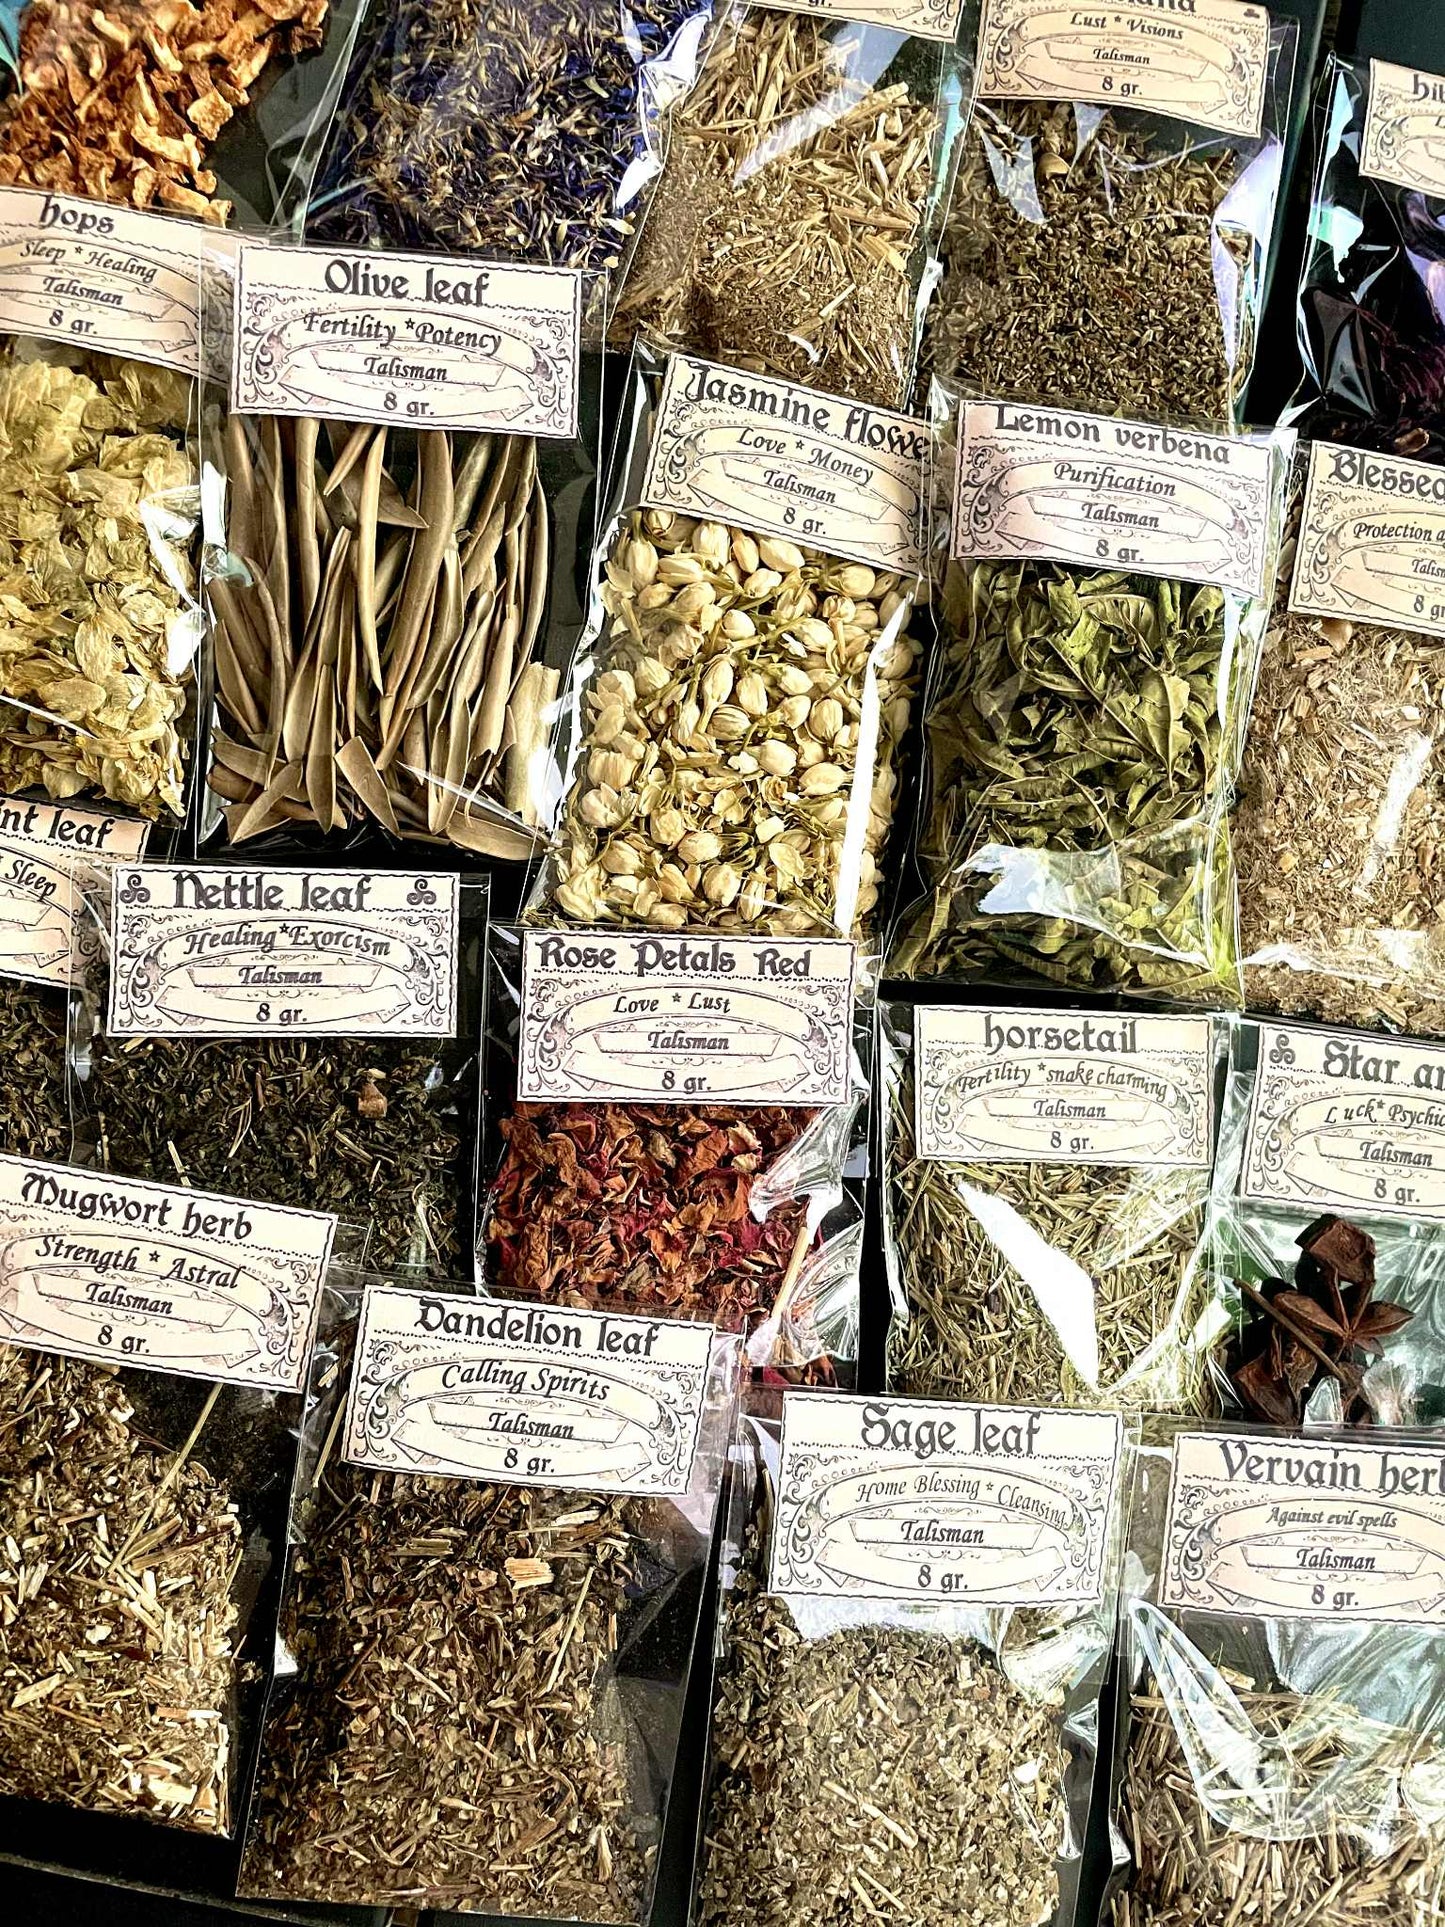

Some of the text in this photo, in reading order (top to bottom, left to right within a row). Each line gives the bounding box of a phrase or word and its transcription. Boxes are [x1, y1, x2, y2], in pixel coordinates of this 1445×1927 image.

[1070, 12, 1185, 41] Lust Visions
[1092, 47, 1151, 65] Talisman
[1102, 76, 1143, 96] 8 gr.
[20, 240, 158, 284] Sleep Healing
[43, 276, 124, 306] Talisman
[324, 259, 490, 307] Olive leaf
[49, 310, 98, 335] 8 gr.
[302, 313, 502, 357] Fertility Potency
[363, 355, 448, 381] Talisman
[383, 392, 434, 418] 8 gr.
[685, 364, 831, 431] Jasmine
[995, 405, 1231, 464] Lemon verbena
[740, 428, 874, 486] Love Money
[763, 469, 836, 504] Talisman
[1053, 462, 1177, 497] Purification
[783, 507, 826, 535] 8 gr.
[1080, 503, 1160, 528] Talisman
[1353, 521, 1432, 541] Protection
[1096, 540, 1144, 563] 8 gr.
[1413, 594, 1424, 613] 8
[48, 808, 116, 849] leaf
[4, 859, 57, 902] Sleep
[172, 872, 372, 912] Nettle leaf
[183, 924, 391, 956] Healing Exorcism
[534, 936, 812, 978] Rose Petals Red
[238, 964, 322, 985] Talisman
[256, 1002, 307, 1026] 8 gr.
[613, 992, 731, 1013] Love Lust
[648, 1030, 730, 1051] Talisman
[1323, 1040, 1401, 1084] Star
[661, 1070, 712, 1094] 8 gr.
[958, 1061, 1168, 1102] Fertility snake charming
[1033, 1098, 1106, 1118] Talisman
[1050, 1130, 1094, 1153] 8 gr.
[1360, 1140, 1433, 1166] Talisman
[20, 1172, 252, 1239] Mugwort herb
[1374, 1178, 1420, 1205] 8 gr.
[35, 1234, 242, 1290] Strength Astral
[85, 1283, 173, 1315] Talisman
[97, 1325, 150, 1355] 8 gr.
[413, 1299, 660, 1357] Dandelion leaf
[442, 1359, 611, 1402] Calling Spirits
[488, 1411, 575, 1439] Talisman
[861, 1403, 1041, 1460] Sage leaf
[503, 1447, 555, 1477] 8 gr.
[1220, 1440, 1362, 1488] Vervain
[855, 1471, 1069, 1530] Home Blessing Cleansing
[900, 1519, 985, 1544] Talisman
[1266, 1507, 1398, 1532] Against evil spells
[1296, 1547, 1376, 1571] Talisman
[917, 1564, 969, 1593] 8 gr.
[1312, 1584, 1359, 1610] 8 gr.
